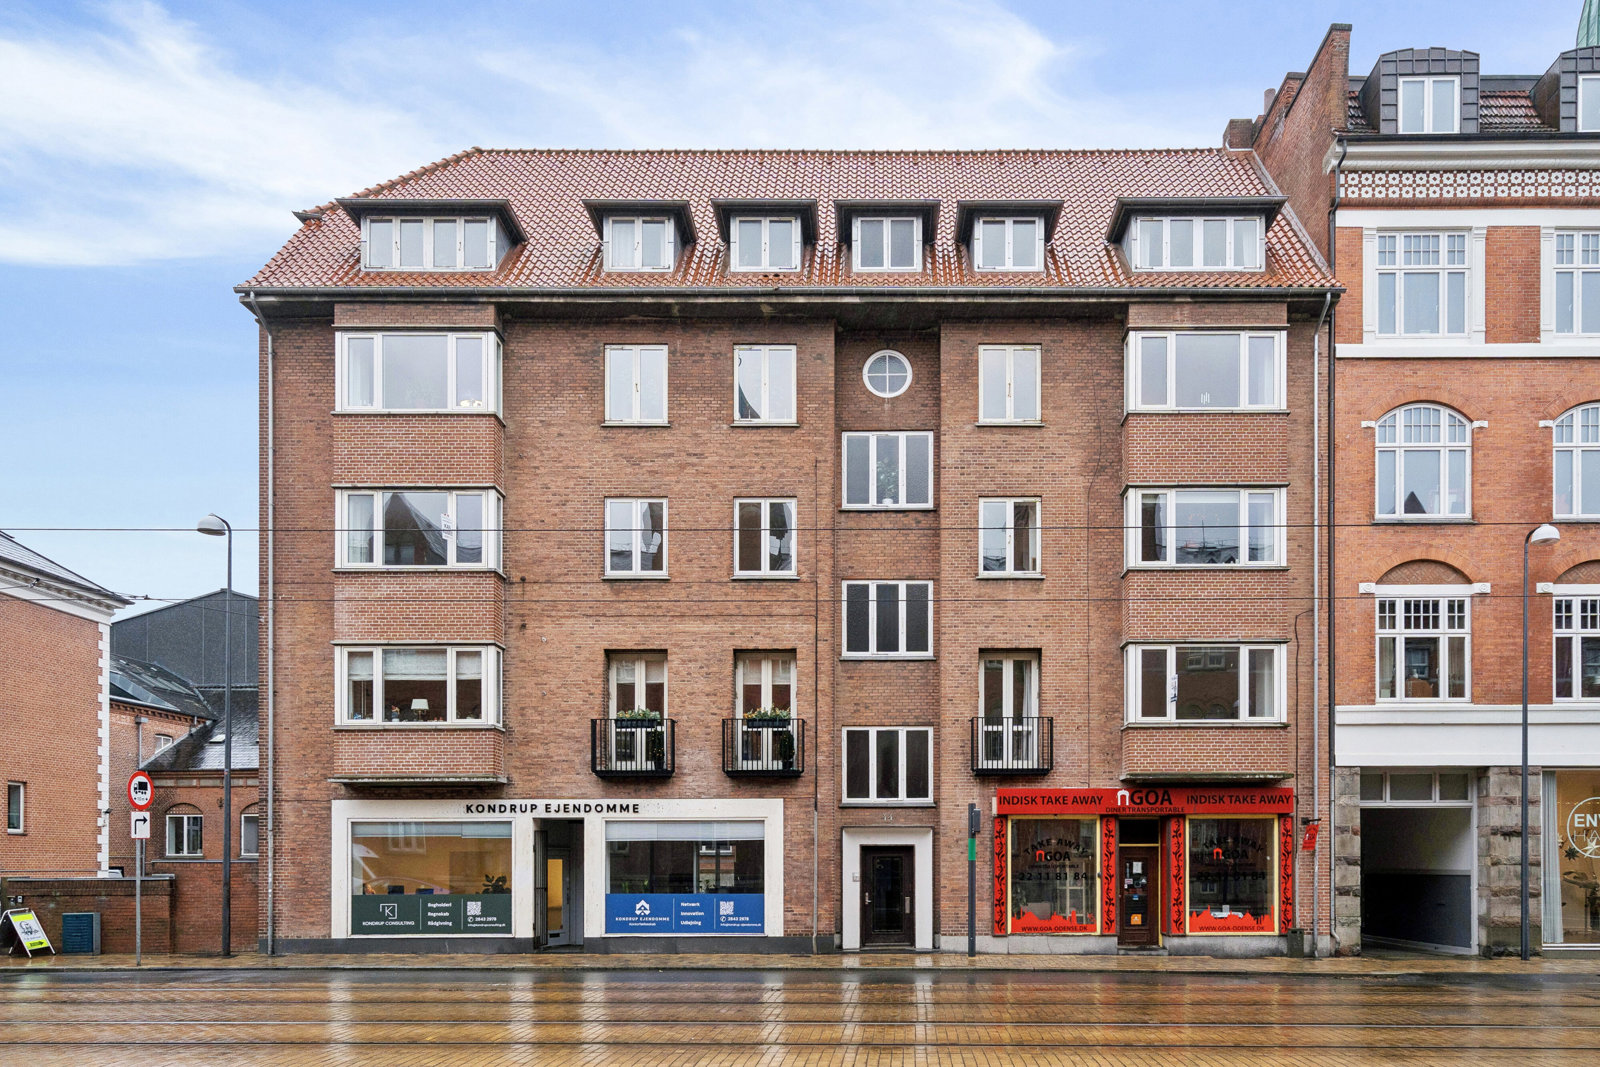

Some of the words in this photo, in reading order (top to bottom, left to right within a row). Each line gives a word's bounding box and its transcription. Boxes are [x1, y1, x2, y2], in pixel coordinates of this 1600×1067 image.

[999, 795, 1038, 806] INDISK
[1041, 795, 1069, 806] TAKE
[1071, 795, 1104, 806] AWAY
[1130, 790, 1173, 806] GOA
[1186, 794, 1226, 805] INDISK
[1228, 794, 1256, 805] TAKE
[1258, 794, 1292, 805] AWAY
[466, 803, 538, 814] KONDRUP
[545, 803, 640, 814] EJENDOMME
[1574, 813, 1600, 828] EN
[1023, 838, 1052, 855] TAKE
[1057, 838, 1089, 855] AWAY
[1045, 851, 1071, 862] GOA
[1019, 872, 1033, 881] 22
[1056, 872, 1068, 881] 81
[1073, 872, 1088, 881] 84
